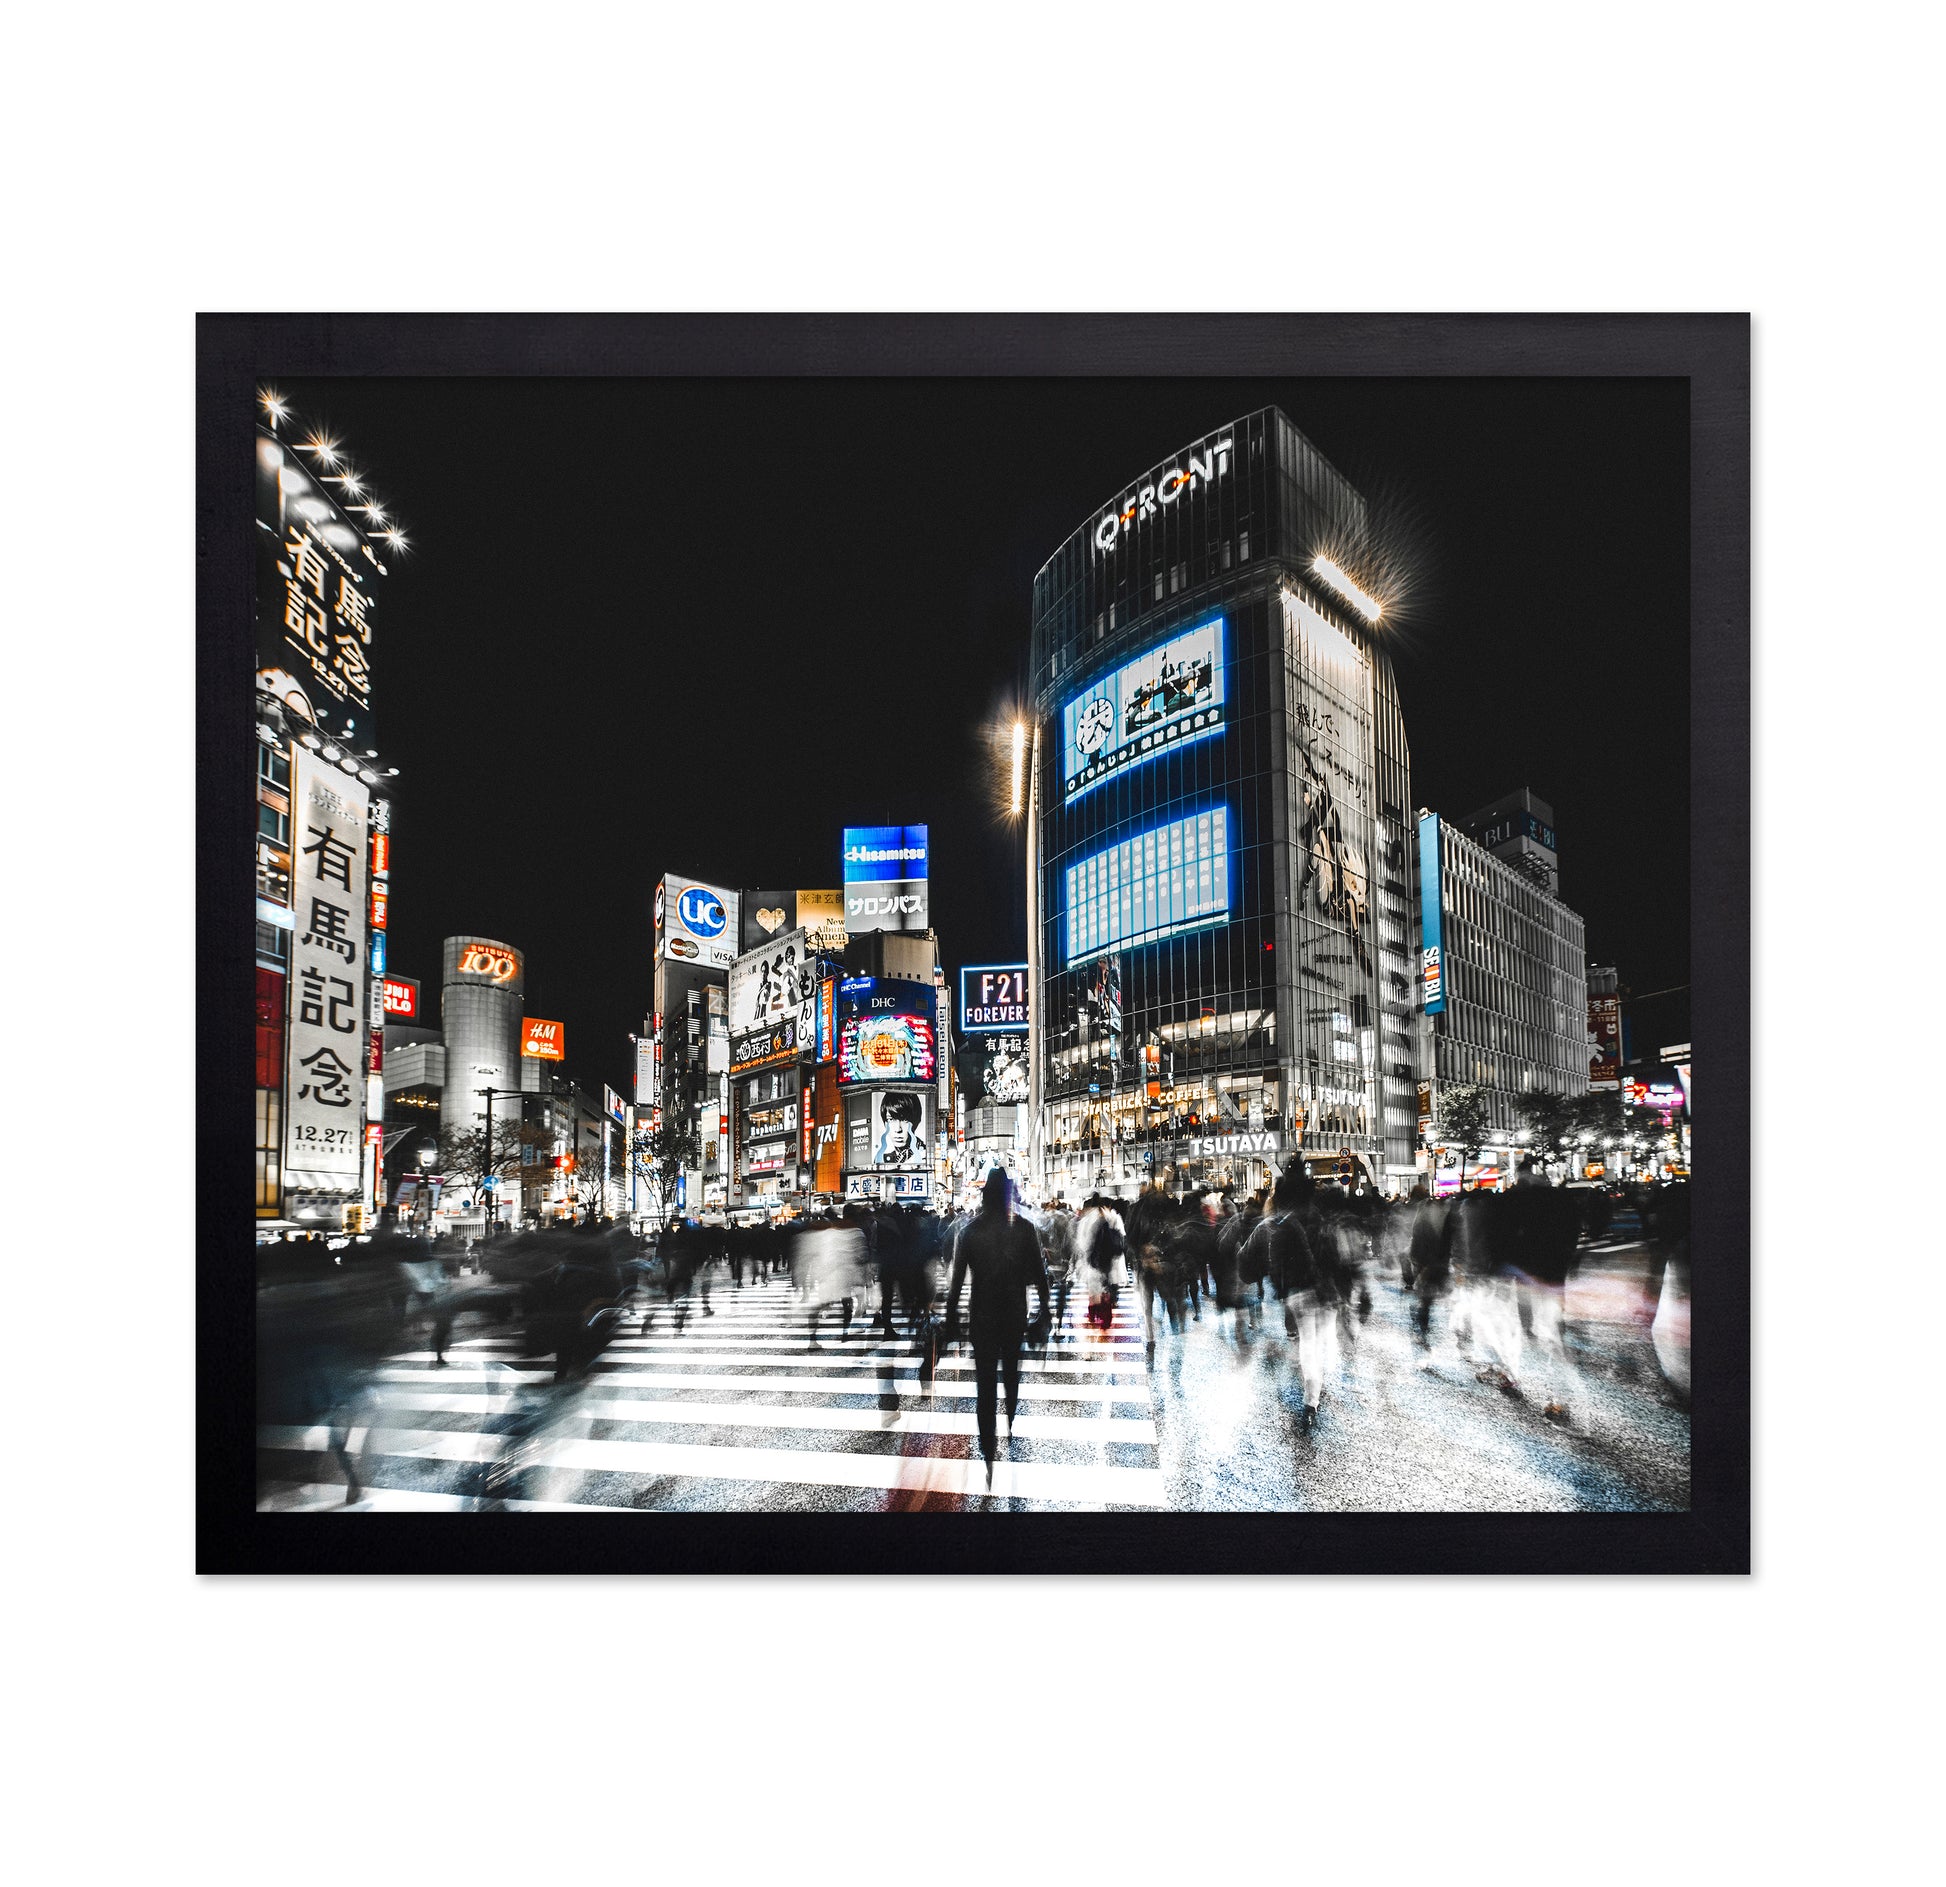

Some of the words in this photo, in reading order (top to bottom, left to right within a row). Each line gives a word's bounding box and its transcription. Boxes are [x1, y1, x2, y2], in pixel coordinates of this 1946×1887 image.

[845, 846, 926, 862] Hisamitsu
[849, 895, 923, 916] サロンパス
[826, 918, 845, 926] New
[470, 945, 515, 961] SHIBUYA
[713, 951, 734, 962] VISA
[299, 825, 357, 1109] 有馬記念
[458, 951, 515, 983] 109
[1423, 946, 1441, 1003] SEIBU
[982, 972, 1023, 1004] F21
[799, 969, 815, 1047] もんじゃ
[871, 997, 896, 1008] DHC
[966, 1004, 1024, 1024] FOREVER
[530, 1023, 557, 1041] H&M
[1082, 1096, 1152, 1117] STARBUCKS
[1158, 1087, 1209, 1105] COFFEE
[295, 1125, 348, 1144] 12.27
[852, 1127, 869, 1138] DMM
[1190, 1133, 1278, 1156] TSUTAYA
